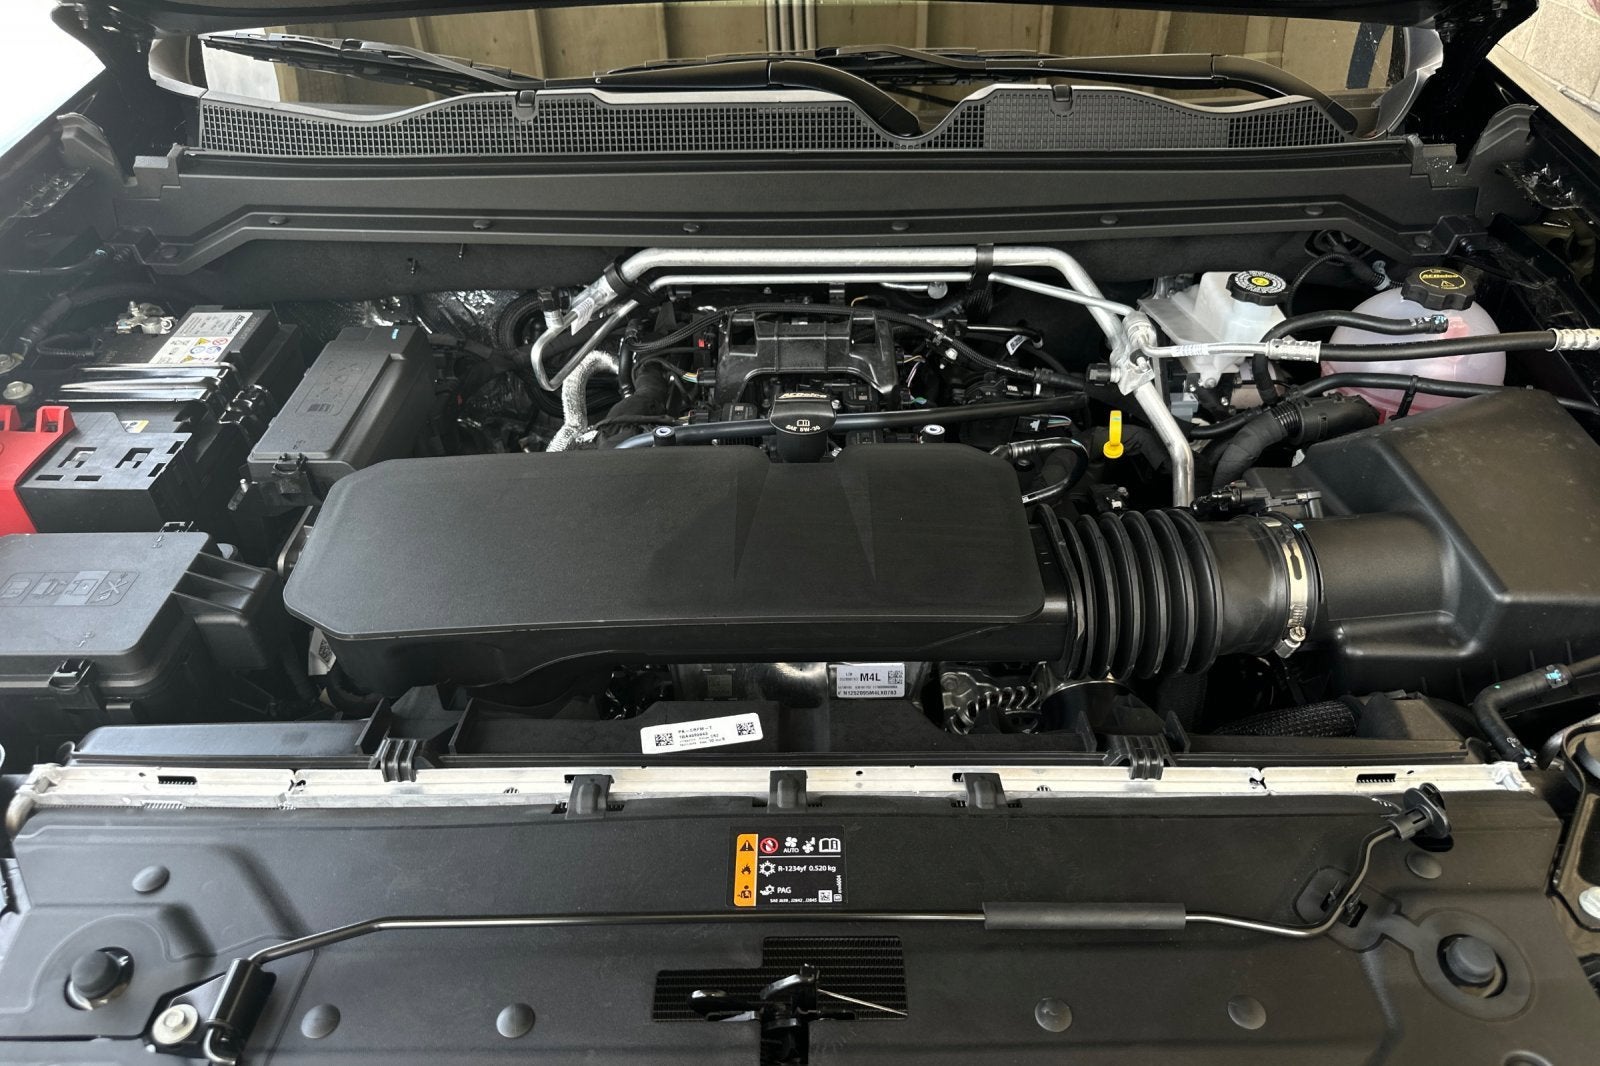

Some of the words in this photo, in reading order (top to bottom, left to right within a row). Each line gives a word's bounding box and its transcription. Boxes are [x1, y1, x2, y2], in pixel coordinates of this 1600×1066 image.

[860, 672, 881, 682] M4L
[777, 865, 807, 873] R-1234yf
[828, 865, 837, 873] kg
[776, 886, 792, 894] PAG
